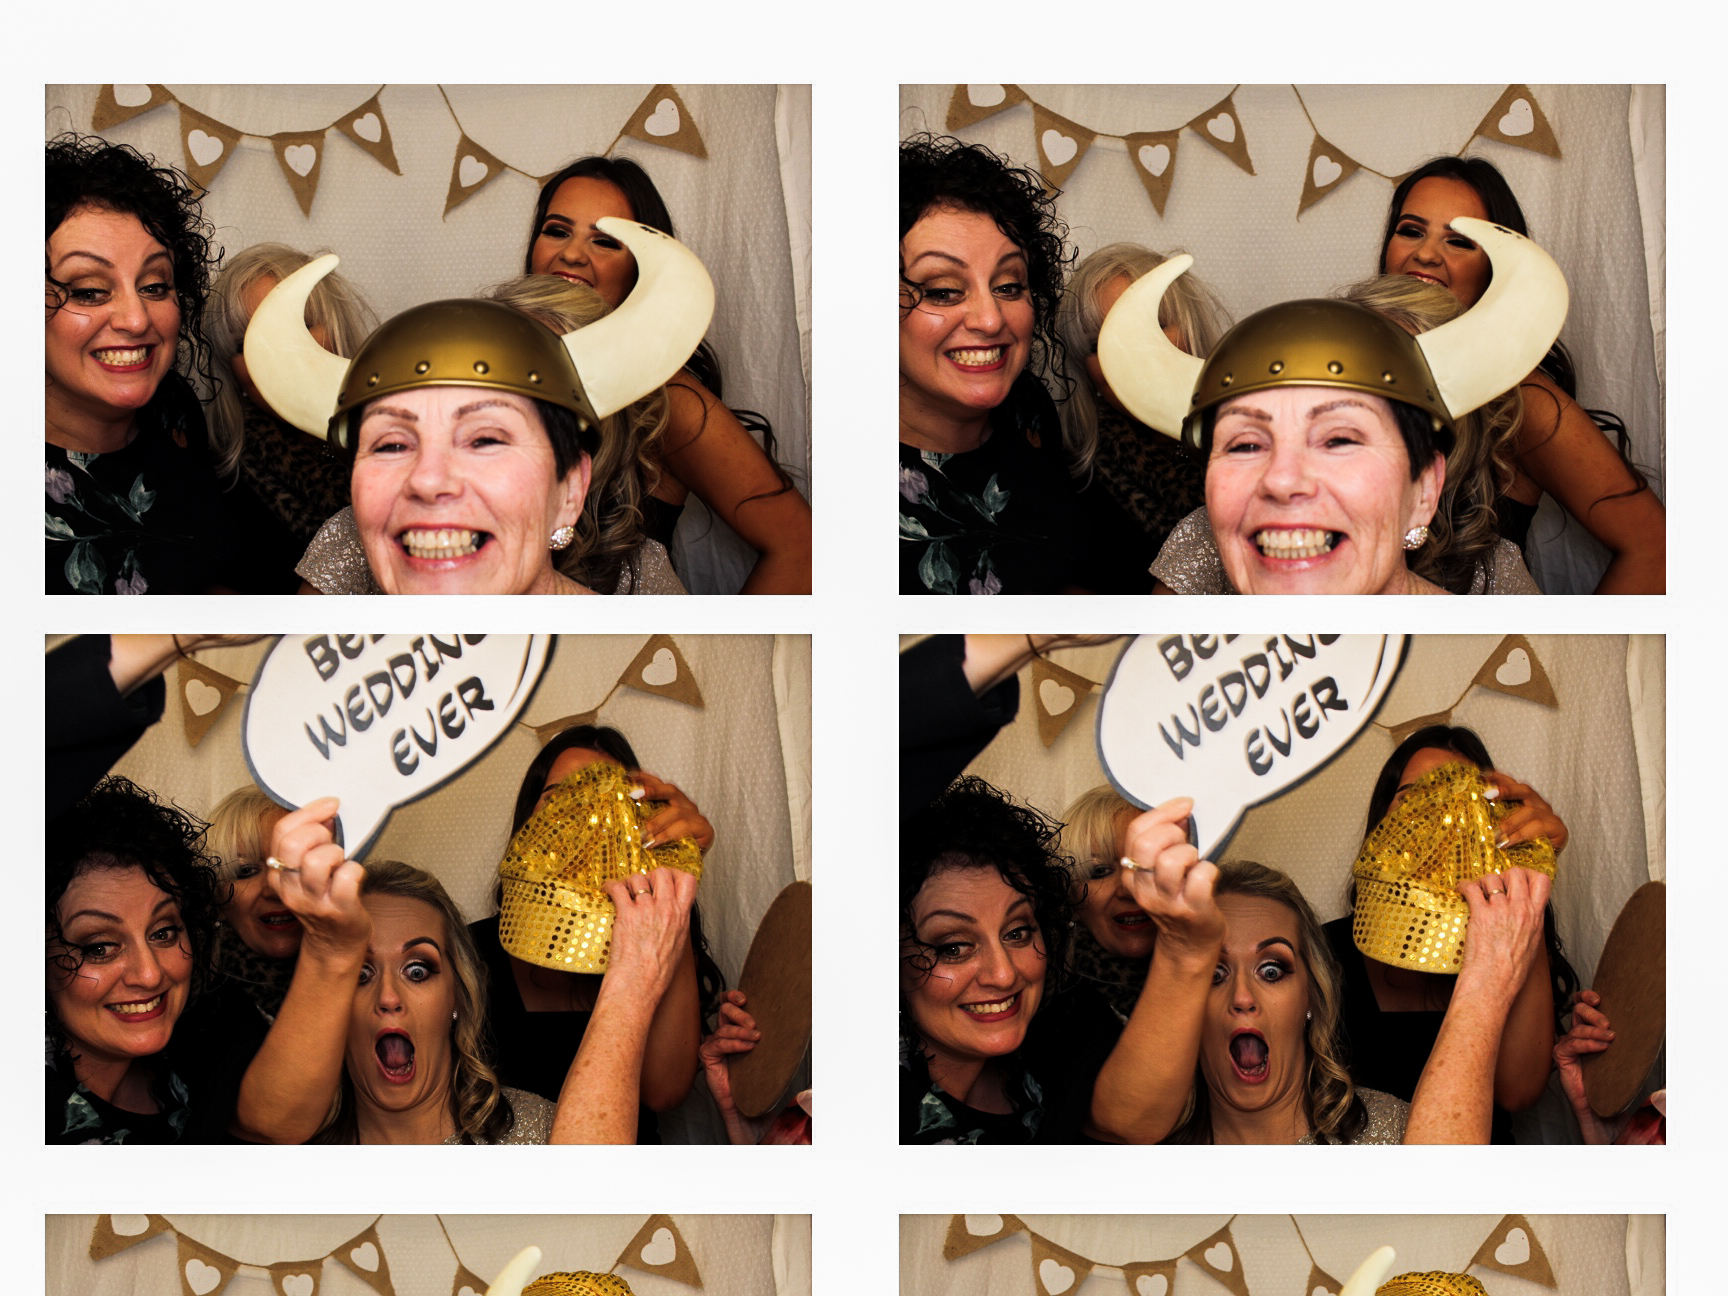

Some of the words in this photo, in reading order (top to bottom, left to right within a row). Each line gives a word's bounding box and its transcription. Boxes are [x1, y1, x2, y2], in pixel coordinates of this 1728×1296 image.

[303, 634, 386, 682] BE
[1157, 634, 1240, 682] BE
[390, 676, 495, 776] EVER
[1244, 676, 1349, 776] EVER
